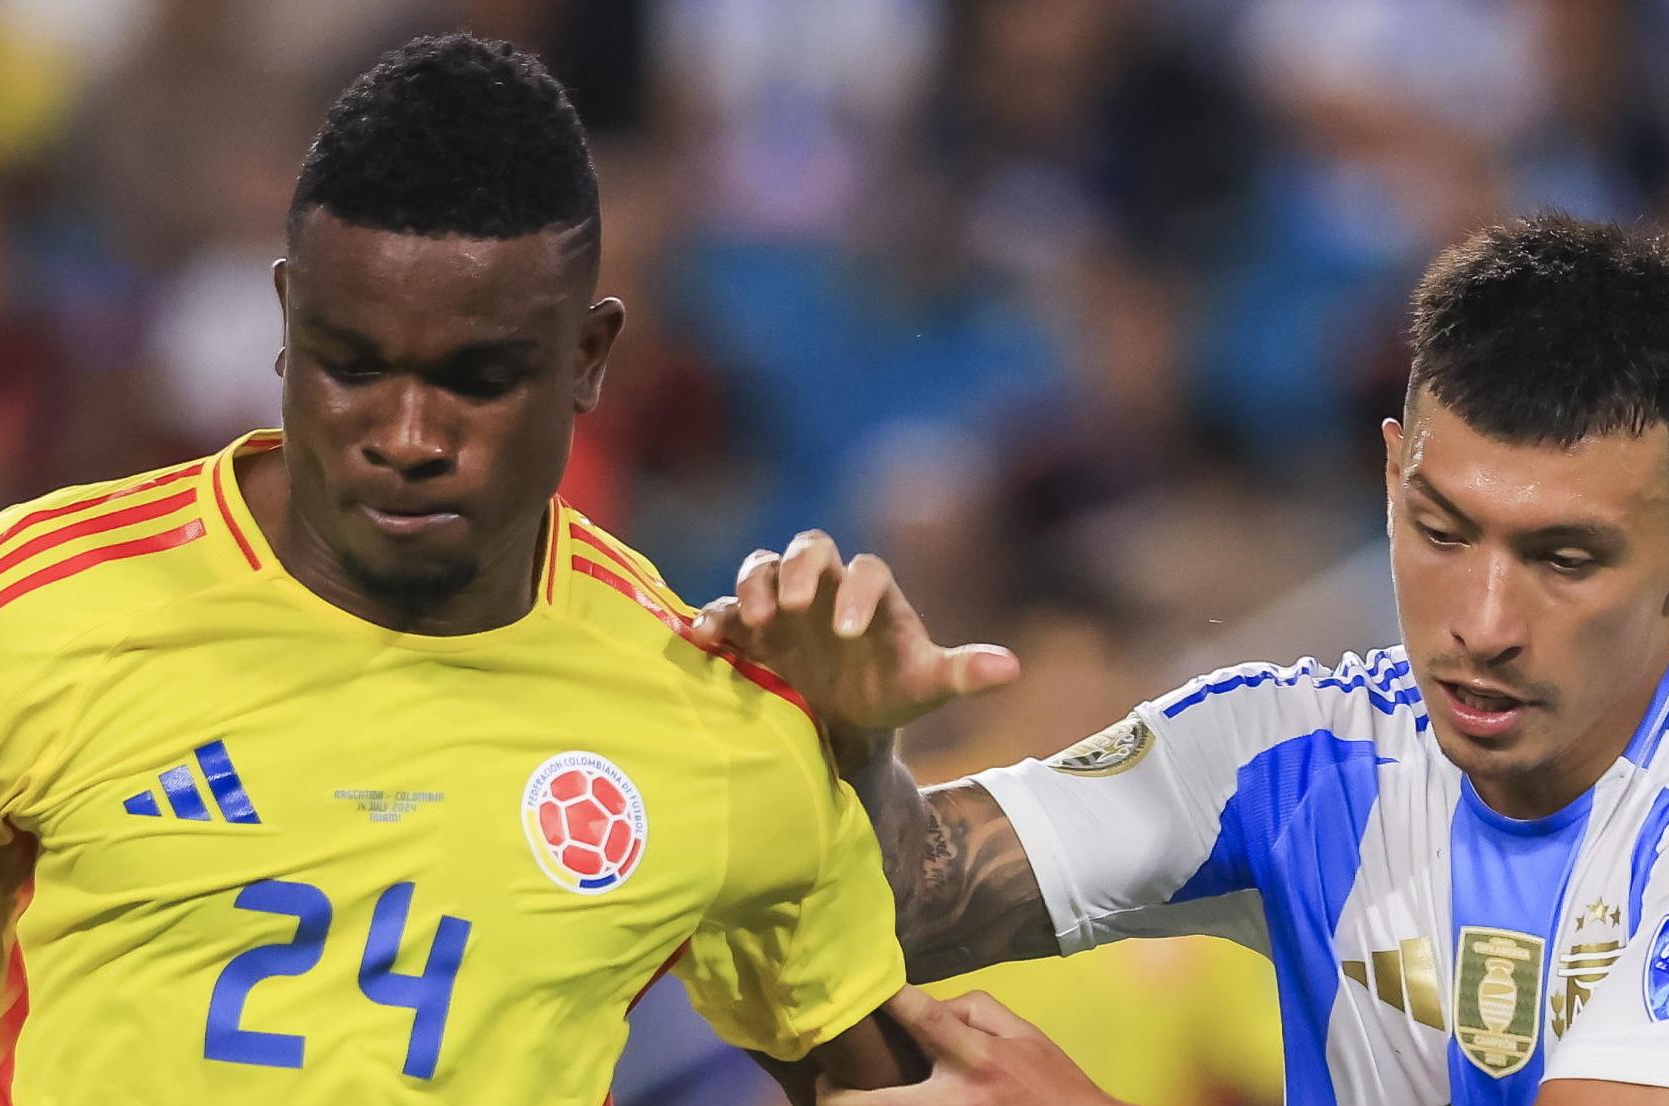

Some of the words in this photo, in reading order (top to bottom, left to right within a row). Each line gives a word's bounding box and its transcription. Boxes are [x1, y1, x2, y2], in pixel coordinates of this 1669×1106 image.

[564, 756, 622, 785] COLOMBIANA
[204, 878, 472, 1080] 24
[1655, 961, 1668, 970] EL
